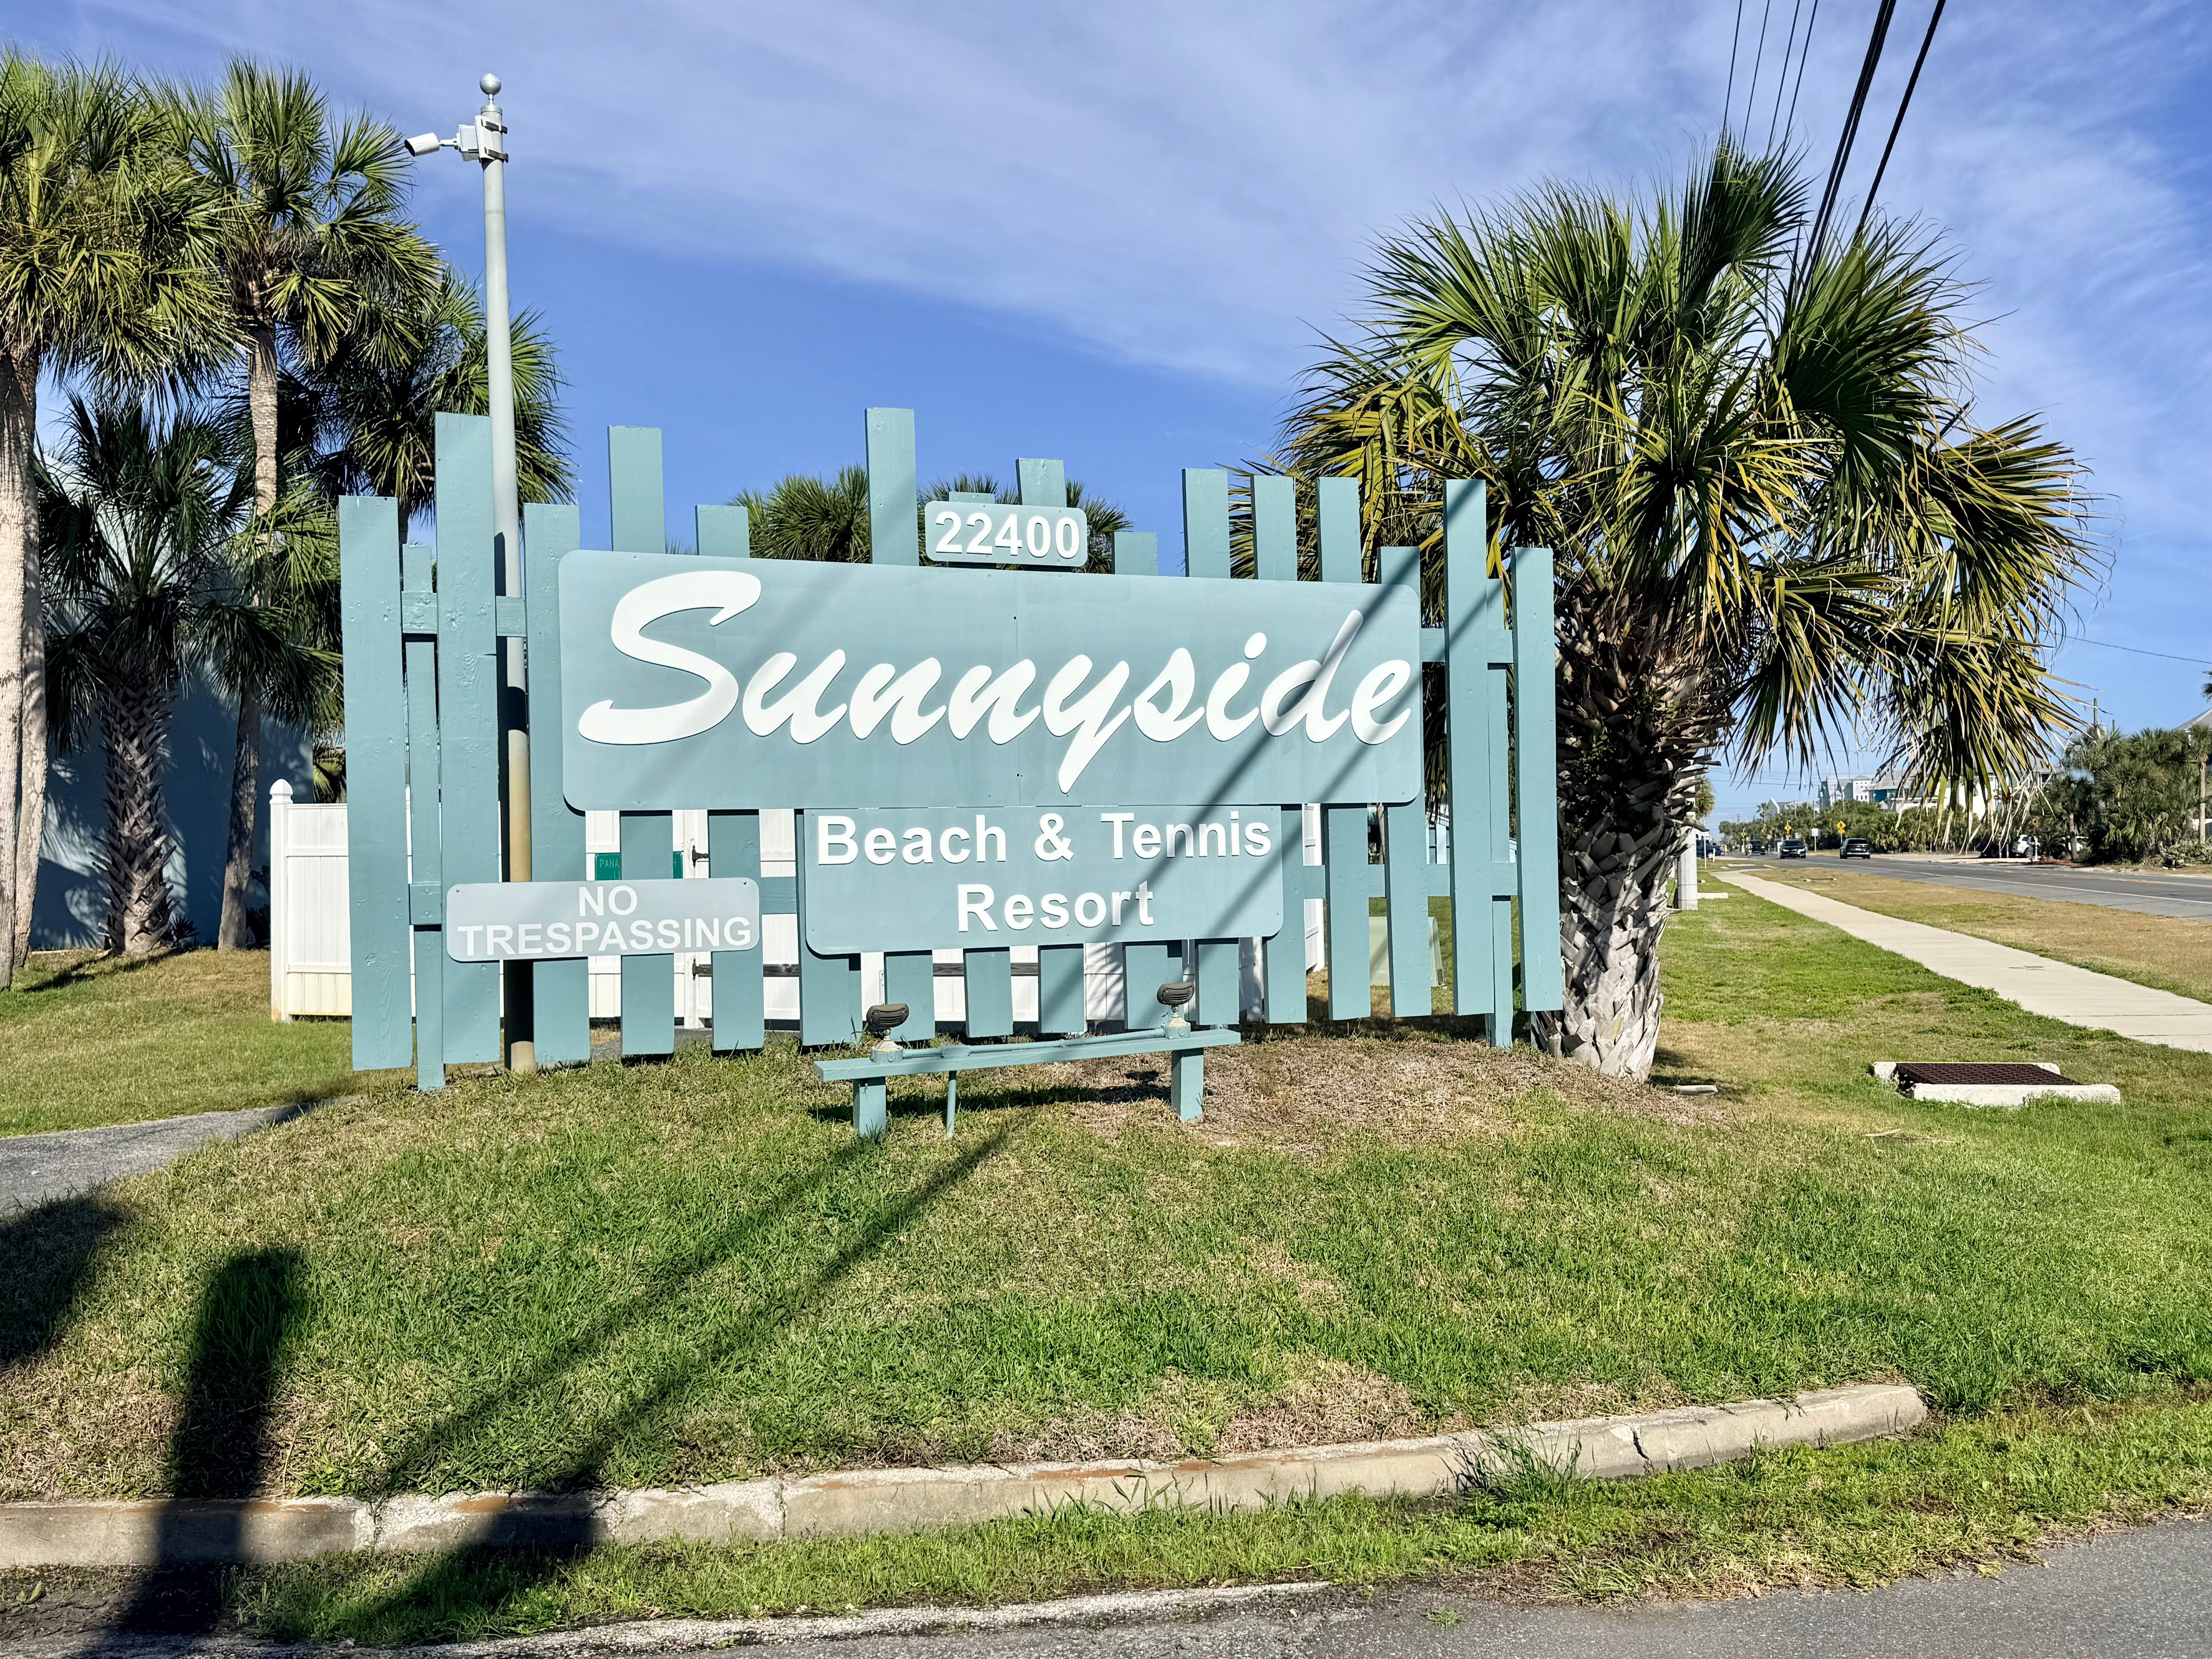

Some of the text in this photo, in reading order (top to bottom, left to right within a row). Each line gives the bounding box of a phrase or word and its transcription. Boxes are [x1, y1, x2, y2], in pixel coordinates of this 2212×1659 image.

[934, 510, 1080, 558] 22400
[578, 570, 1412, 793] Sunnyside
[817, 810, 1272, 865] Beach & Tennis
[600, 858, 620, 868] PANA
[579, 885, 638, 917] NO
[957, 881, 1154, 932] Resort
[457, 916, 751, 957] TRESPASSING
